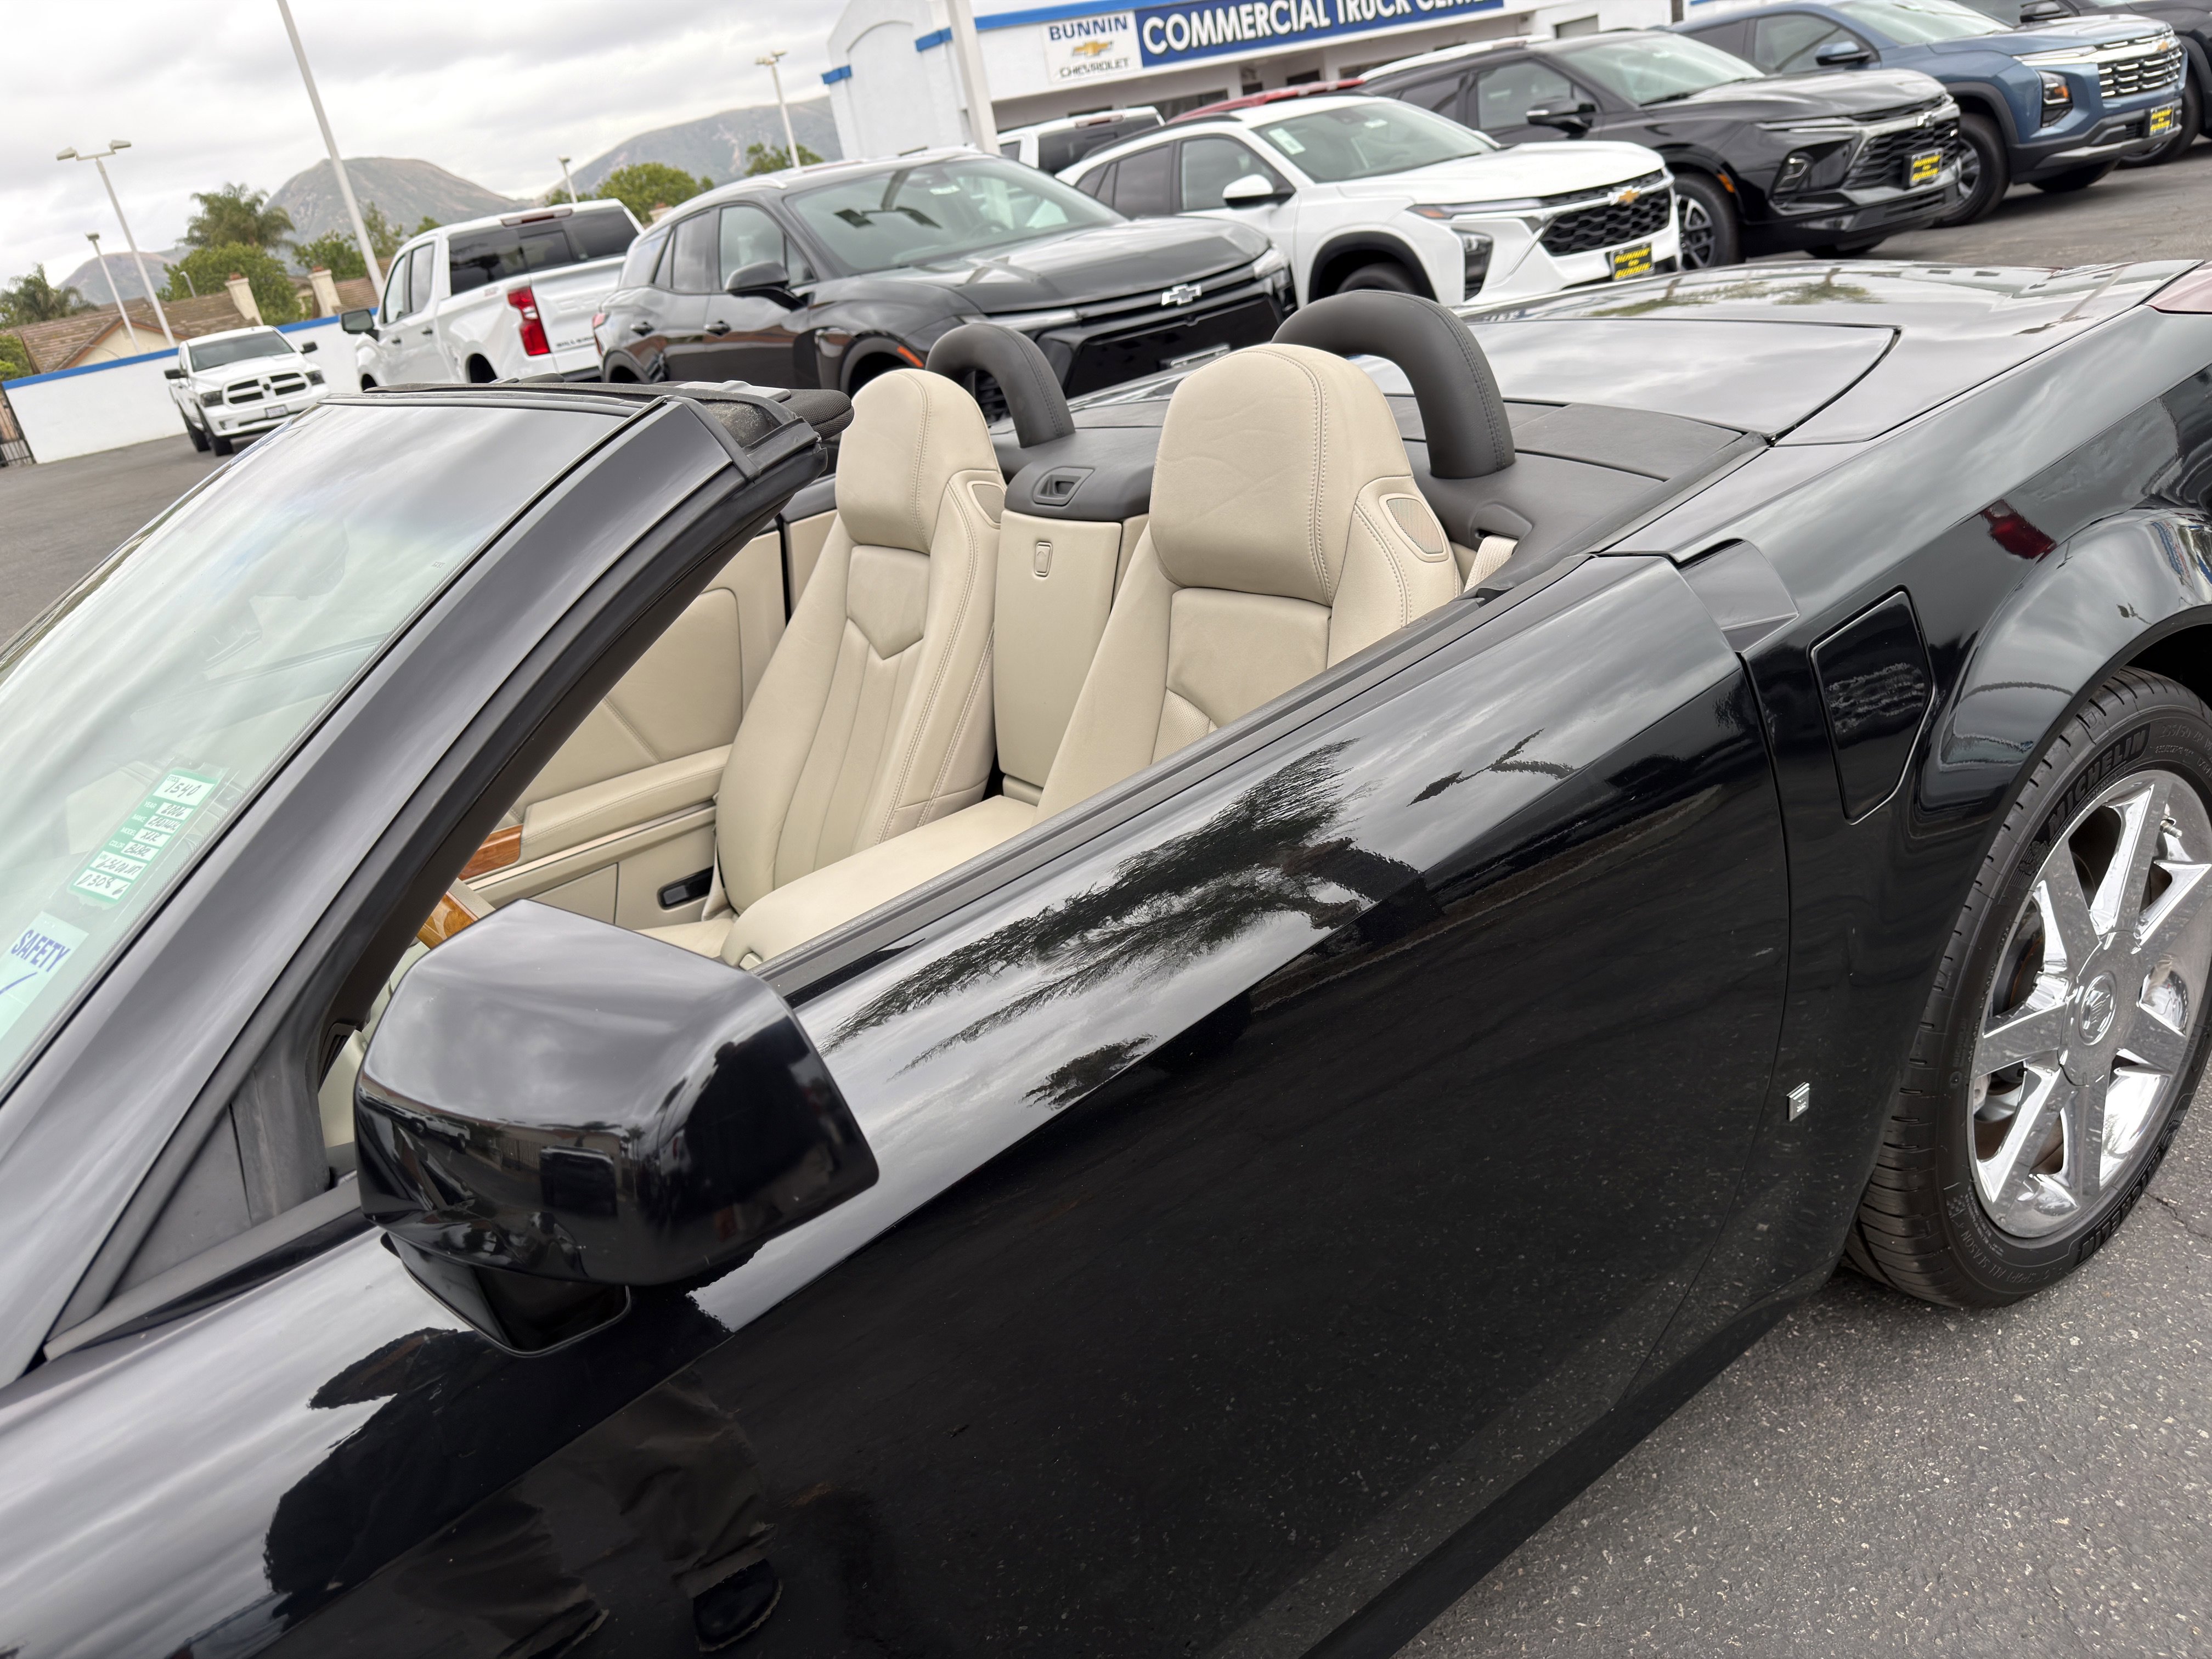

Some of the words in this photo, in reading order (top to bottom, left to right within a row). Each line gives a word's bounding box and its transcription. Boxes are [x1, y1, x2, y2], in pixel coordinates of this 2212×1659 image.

[1049, 15, 1128, 41] BUNNIN
[1142, 0, 1331, 54] COMMERCIAL
[1059, 57, 1130, 78] CHEVROLET
[164, 781, 202, 798] 1540
[2048, 730, 2147, 838] MICHELIN
[144, 800, 158, 809] YEAR
[160, 804, 187, 817] 2006
[131, 814, 148, 823] MAKE
[121, 827, 137, 837] MODEL
[109, 840, 126, 849] COLOR
[10, 929, 71, 973] SAFETY
[1960, 1230, 1991, 1268] SEASON
[1989, 1264, 2007, 1278] ALL
